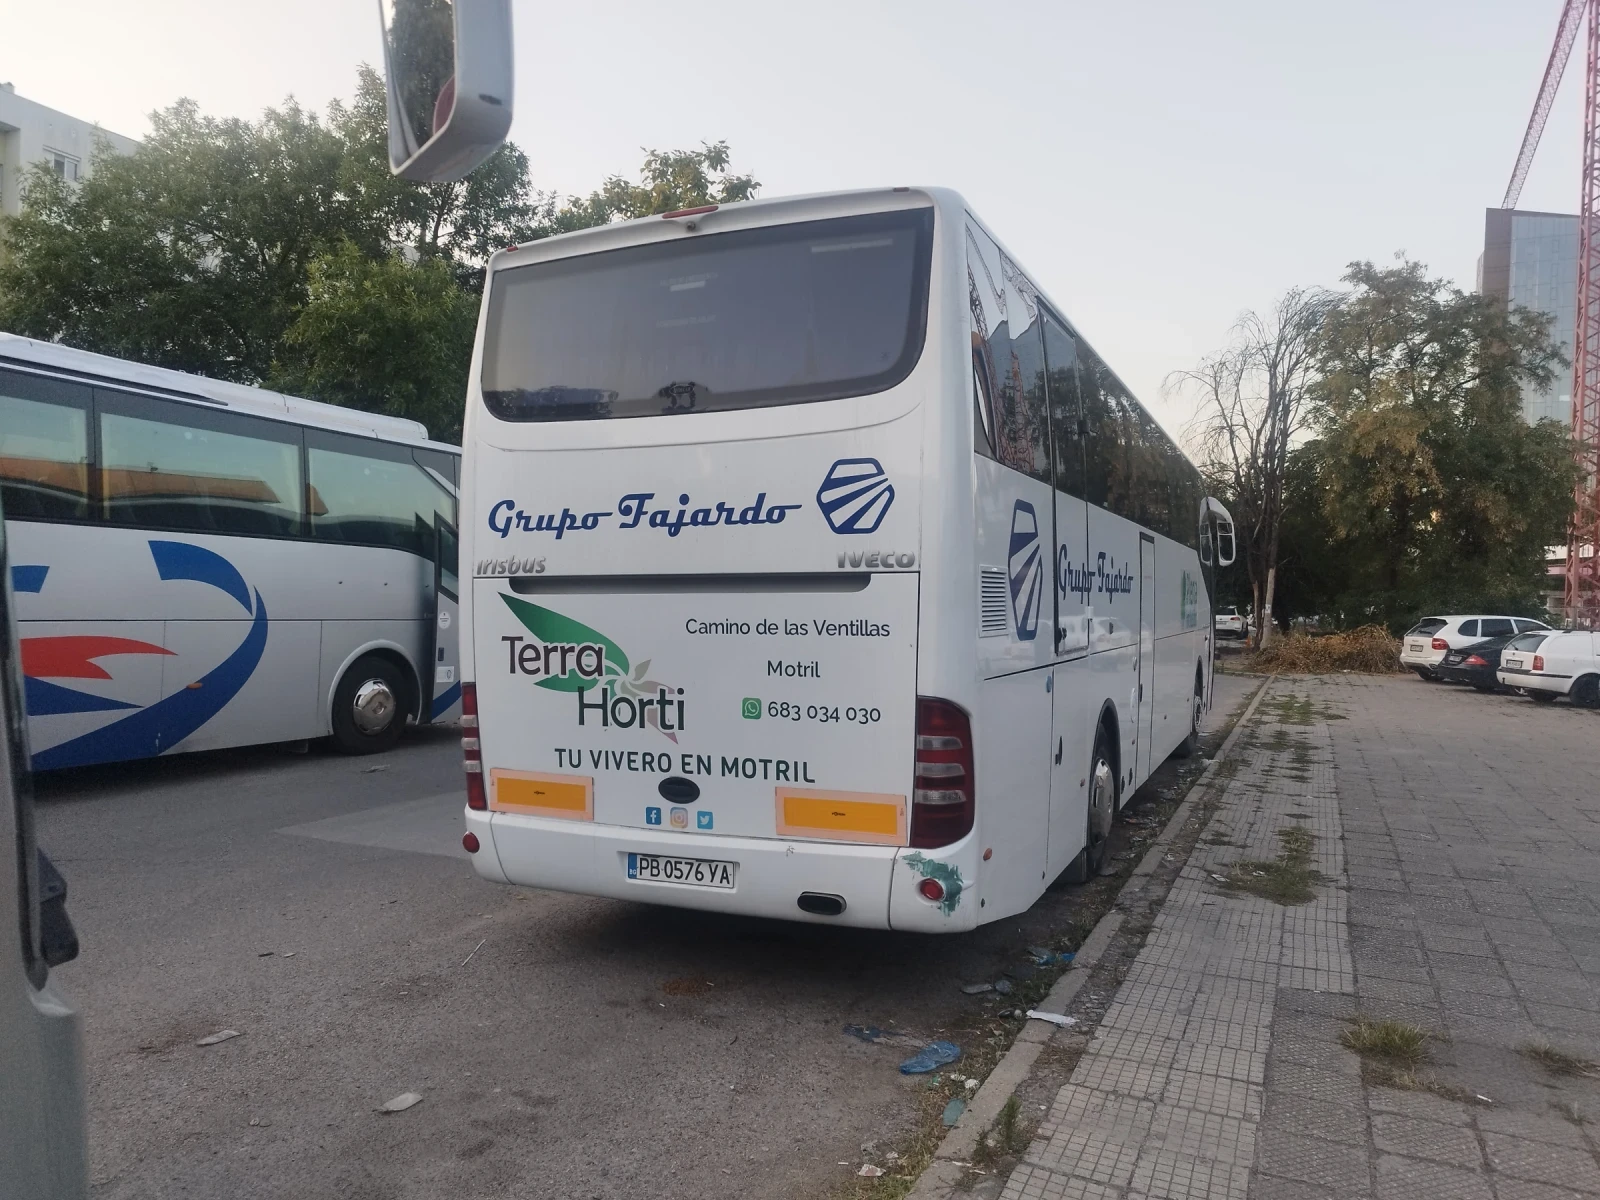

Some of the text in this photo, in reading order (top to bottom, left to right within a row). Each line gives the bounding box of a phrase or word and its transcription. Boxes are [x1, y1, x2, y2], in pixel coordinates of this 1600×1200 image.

[488, 492, 803, 539] Grupo Fajardo
[837, 550, 916, 569] IVECO
[1058, 543, 1096, 604] Grupo
[1097, 551, 1134, 604] Fajardo
[685, 618, 891, 637] Camino de las Ventillas
[501, 636, 604, 677] Terra
[767, 660, 821, 678] Motril
[577, 686, 685, 731] Horti
[767, 701, 882, 725] 683 034 030
[554, 748, 816, 784] TU VIVERO EN MOTRIL
[639, 857, 661, 878] PB
[663, 859, 705, 882] 0576
